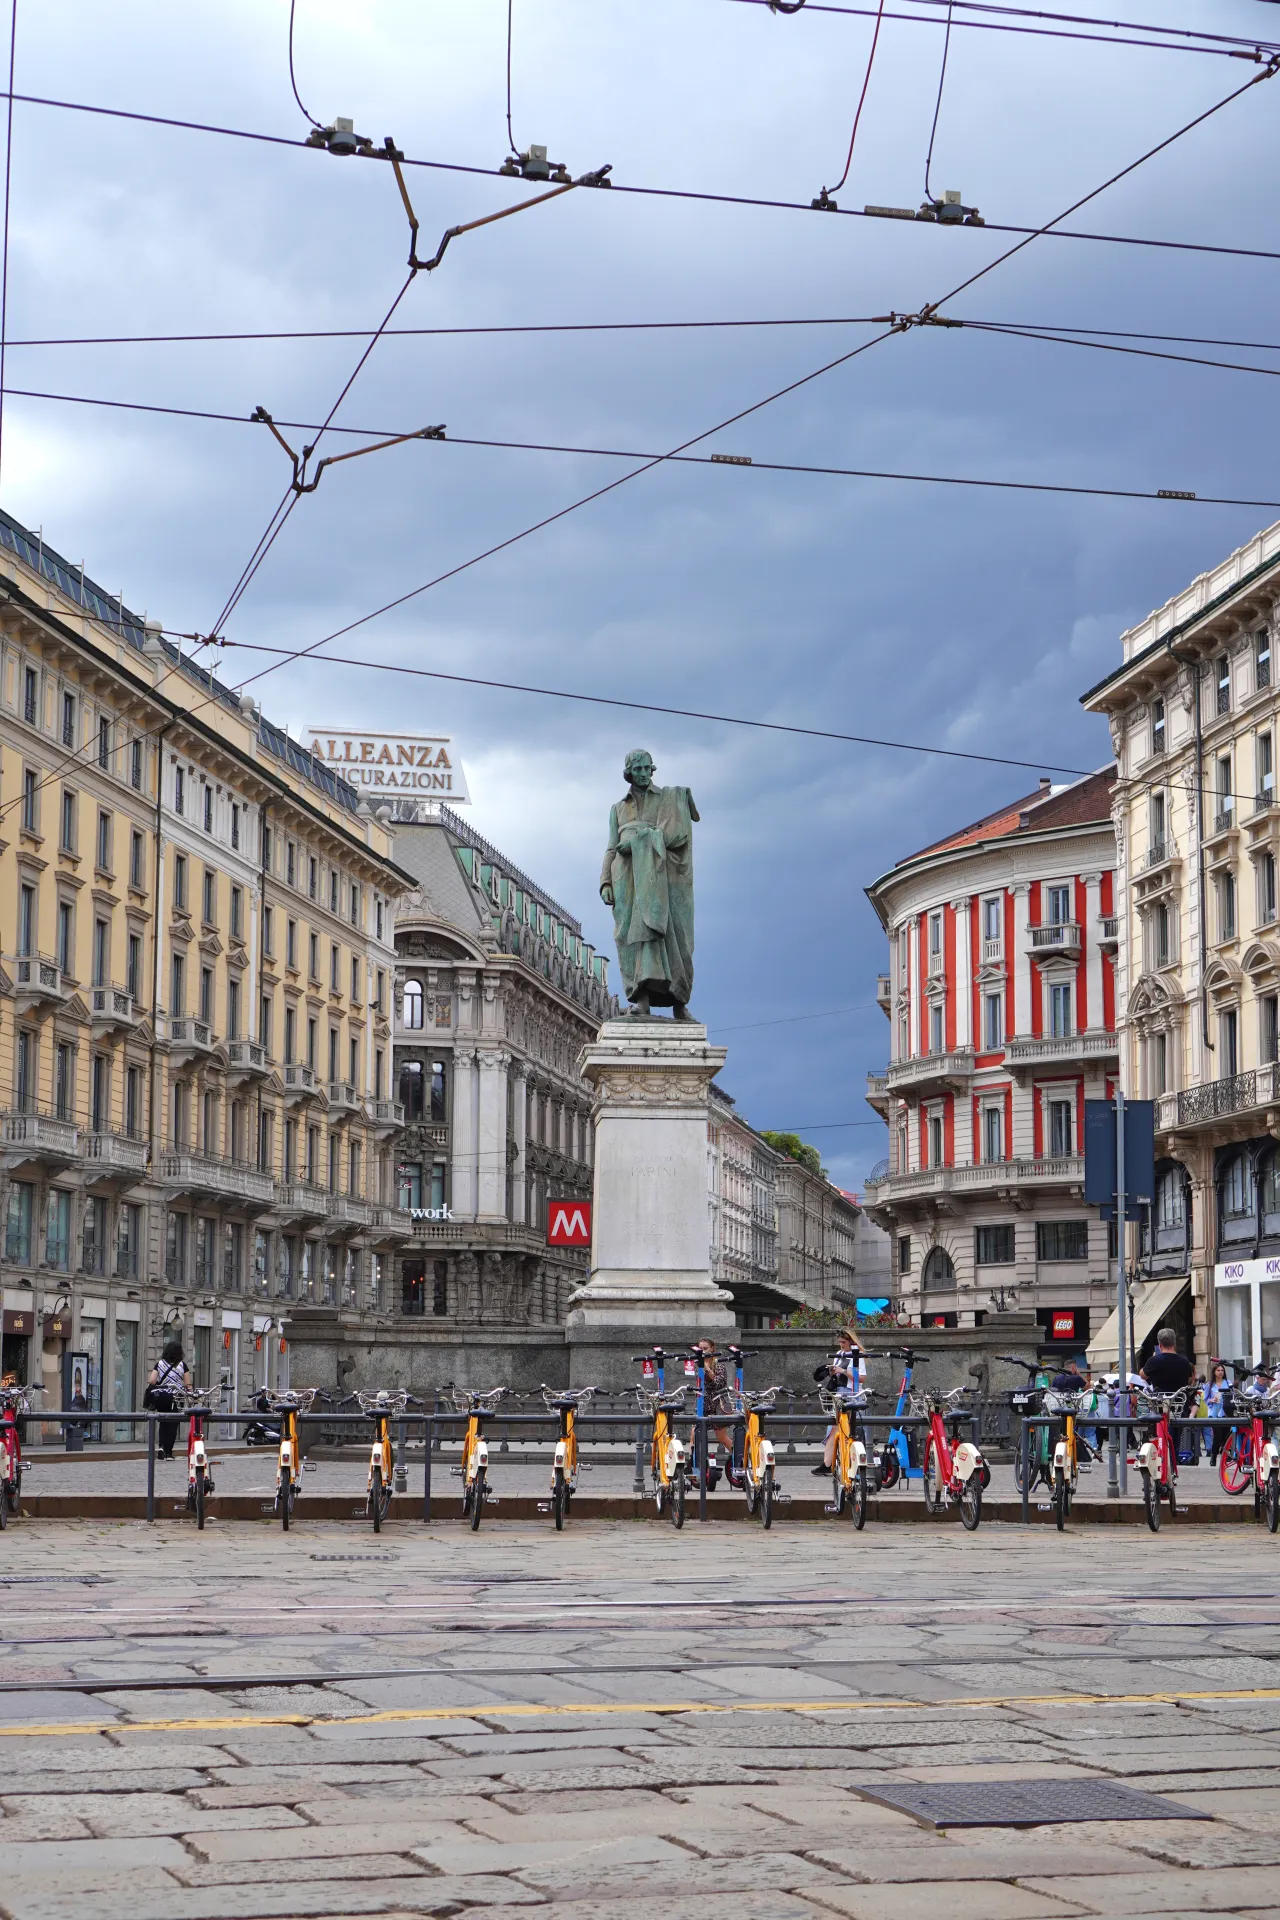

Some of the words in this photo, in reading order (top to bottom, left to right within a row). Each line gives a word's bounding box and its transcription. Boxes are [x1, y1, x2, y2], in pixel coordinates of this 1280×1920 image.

[312, 738, 452, 768] ALLEANZA
[551, 1209, 588, 1237] M
[1224, 1263, 1244, 1278] KIKO
[1054, 1319, 1073, 1331] LEGO
